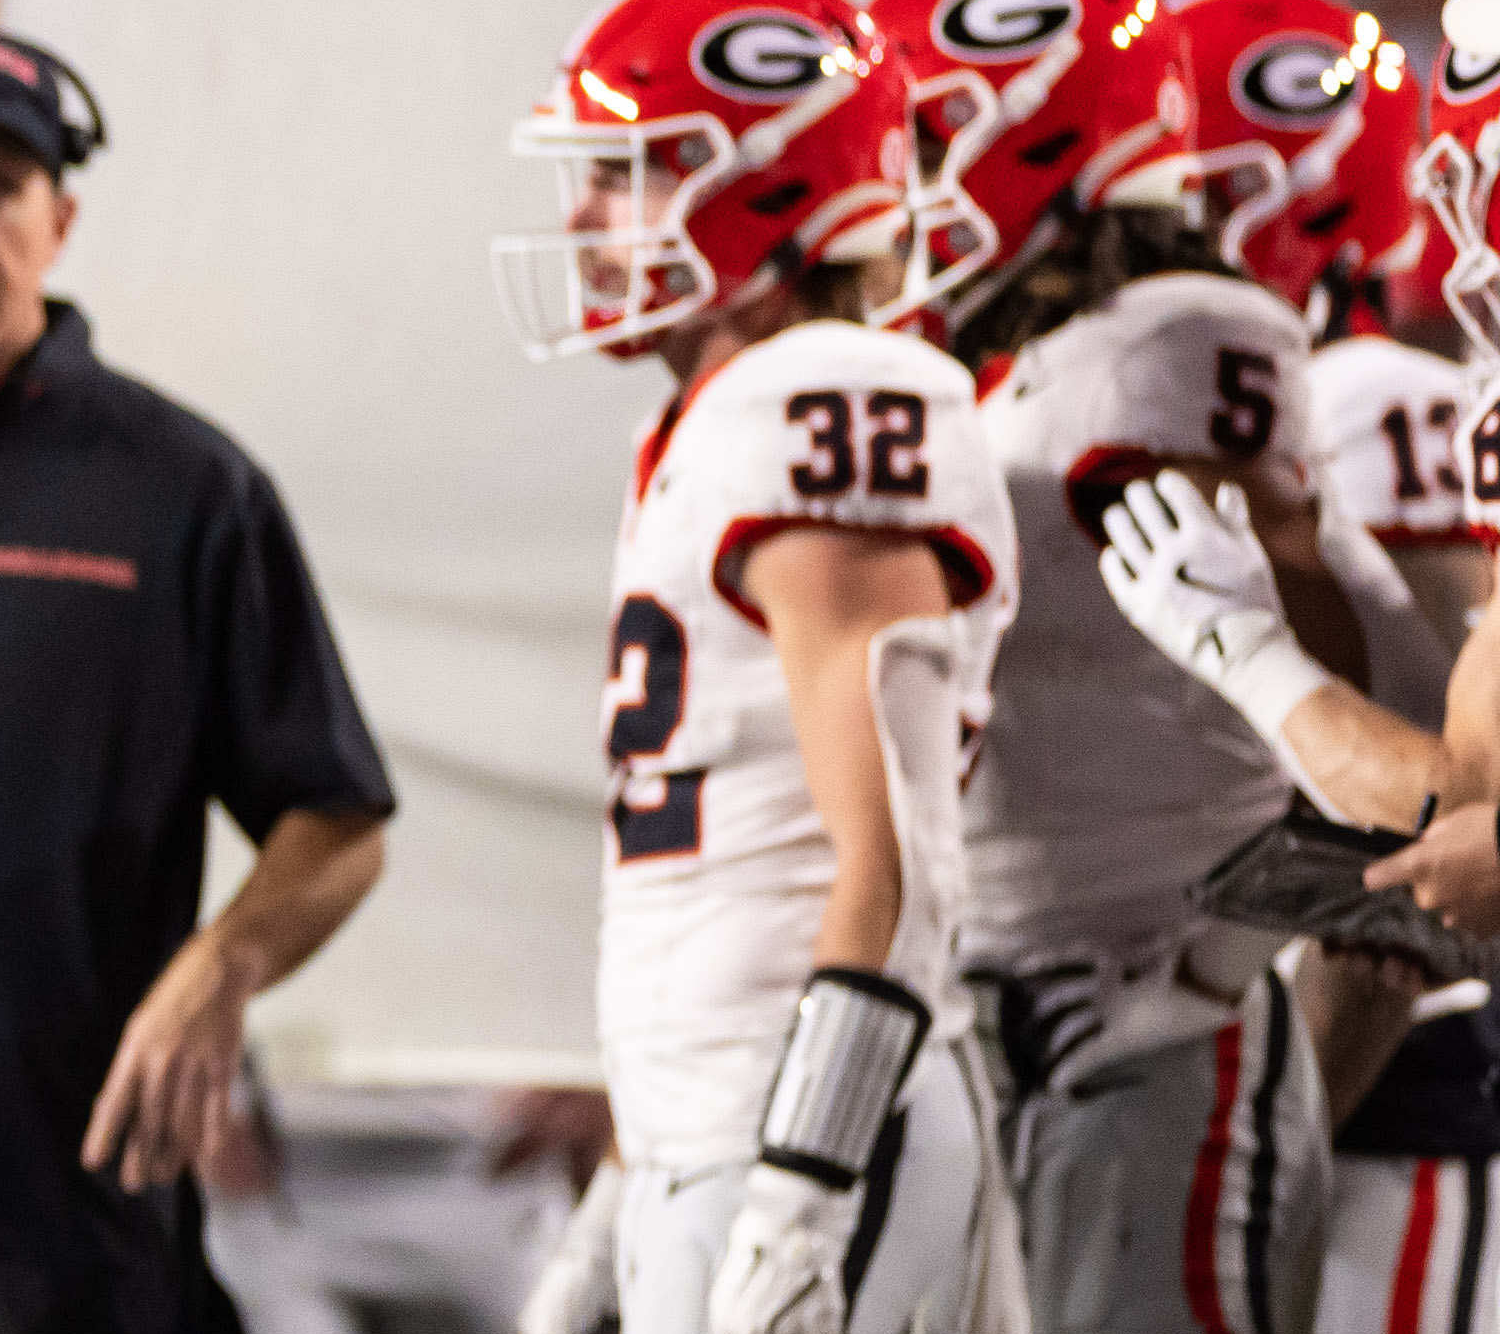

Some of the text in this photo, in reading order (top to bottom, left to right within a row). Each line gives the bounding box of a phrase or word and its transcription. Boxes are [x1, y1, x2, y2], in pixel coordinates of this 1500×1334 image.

[695, 10, 838, 98] G
[1235, 33, 1362, 123] G
[786, 389, 930, 498] 32
[1210, 347, 1277, 459] 5
